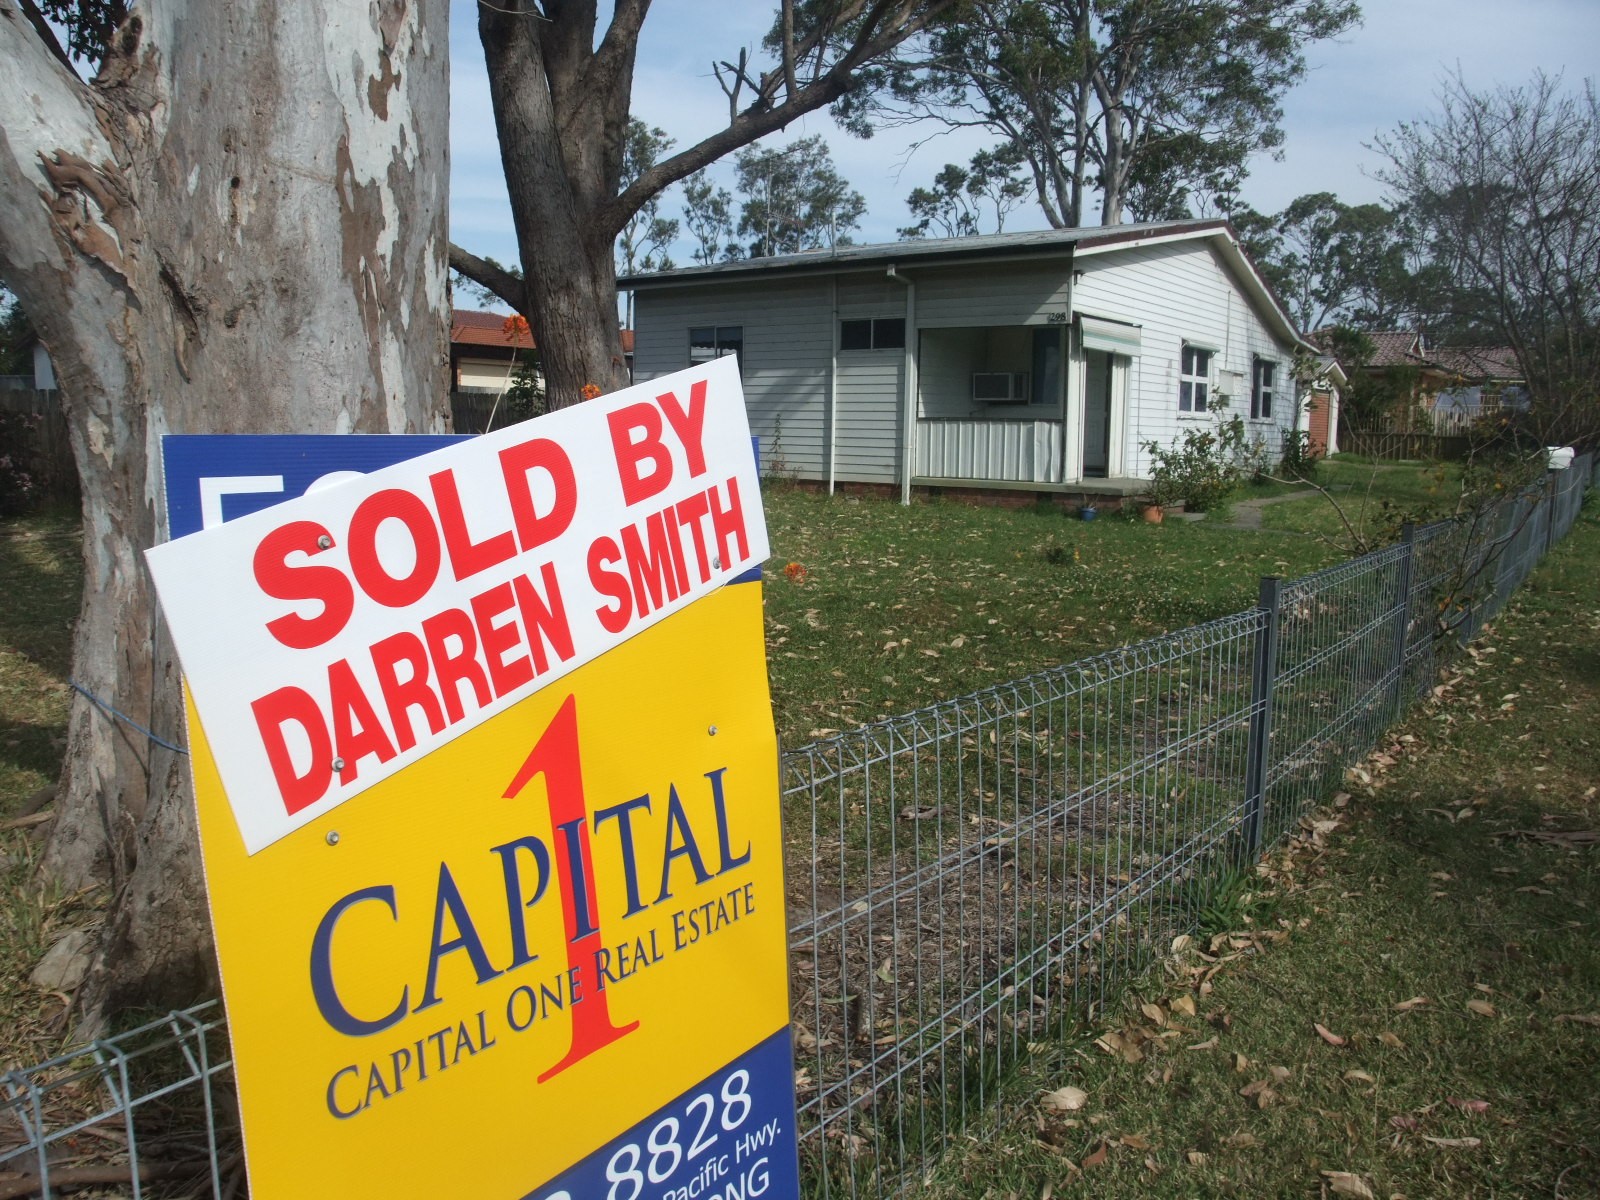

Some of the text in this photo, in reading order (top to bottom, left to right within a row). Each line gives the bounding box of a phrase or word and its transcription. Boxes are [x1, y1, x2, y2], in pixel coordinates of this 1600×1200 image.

[253, 380, 707, 650] SOLD BY
[250, 477, 750, 816] DARREN SMITH
[309, 767, 752, 1037] CAPITAL
[326, 882, 756, 1121] CAPITAL ONE REAL ESTATE
[501, 693, 640, 1084] 1
[605, 1069, 752, 1200] 8828
[707, 1157, 770, 1200] NG
[735, 1118, 782, 1165] Hwy.
